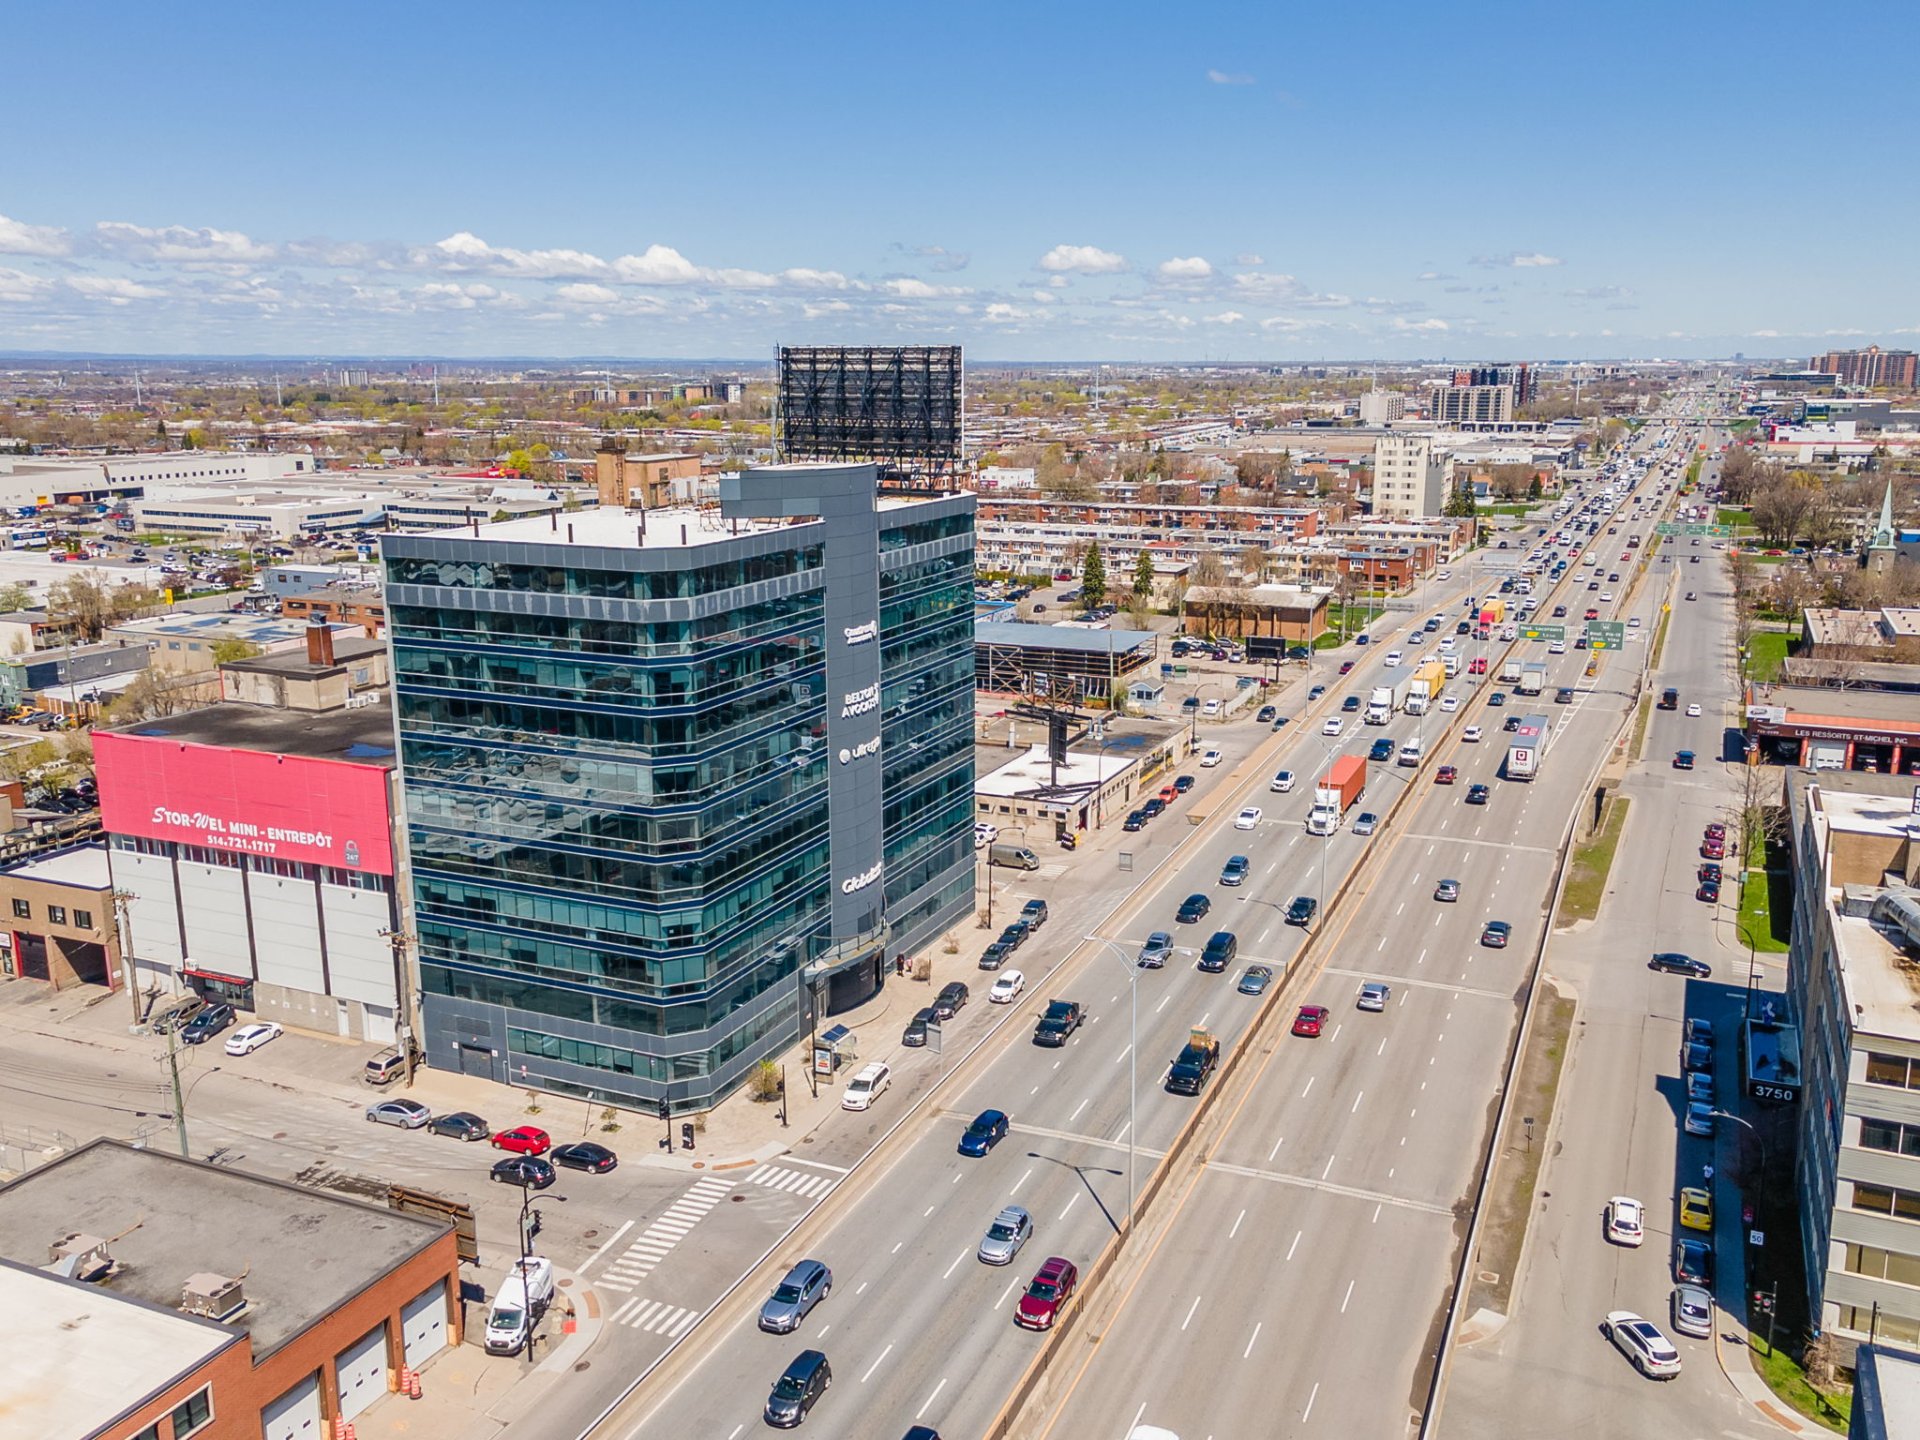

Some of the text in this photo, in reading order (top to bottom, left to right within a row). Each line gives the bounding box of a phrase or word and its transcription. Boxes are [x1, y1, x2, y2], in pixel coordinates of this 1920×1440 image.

[1795, 729, 1810, 737] LES
[1812, 730, 1852, 740] RESSORTS
[1853, 734, 1893, 743] ST-MICHEL
[152, 807, 226, 833] STOR-WEL
[229, 821, 258, 837] MINI
[267, 827, 333, 848] ENTREPÔT
[207, 835, 276, 853] 514.721.1717
[1755, 1085, 1793, 1101] 3750
[1751, 1234, 1762, 1243] 50
